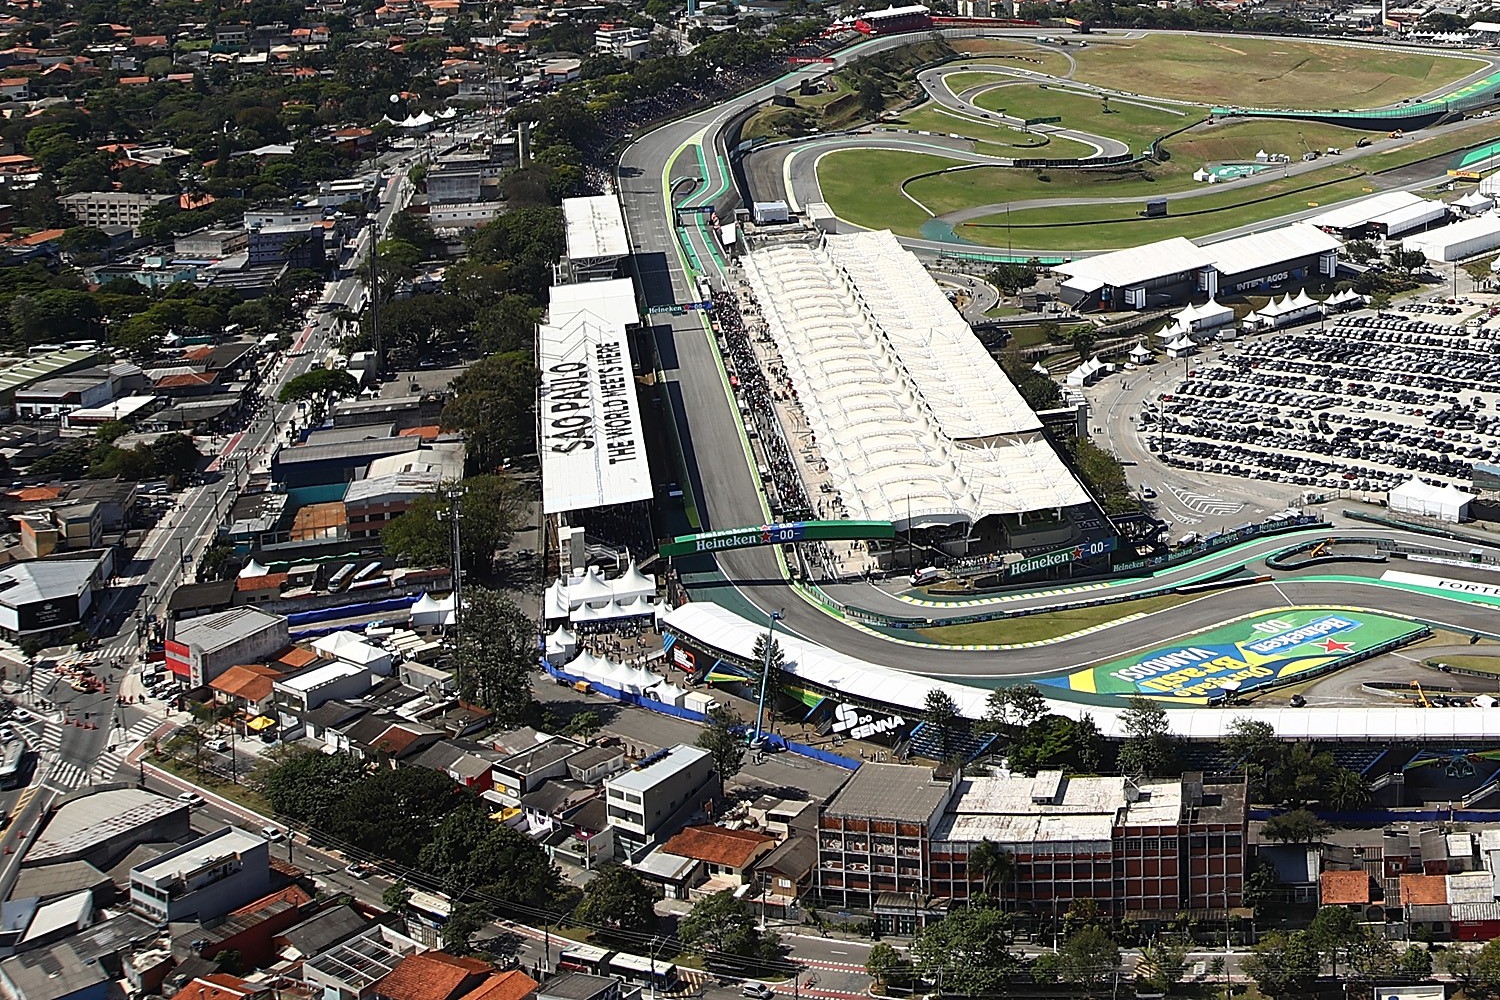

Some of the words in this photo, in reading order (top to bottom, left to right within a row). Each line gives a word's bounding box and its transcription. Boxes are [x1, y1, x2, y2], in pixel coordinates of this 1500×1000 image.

[649, 305, 683, 314] Heineken
[596, 342, 622, 366] HERE
[549, 363, 591, 413] PAULO
[598, 367, 627, 398] MEETS
[603, 400, 633, 440] WORLD
[607, 440, 637, 465] THE
[1259, 519, 1289, 531] Heineken
[695, 534, 757, 551] Heineken
[1167, 548, 1193, 561] Heineken
[1010, 552, 1069, 575] Heineken
[1113, 560, 1144, 573] Heineken
[1249, 616, 1352, 653] Heineken
[1109, 647, 1218, 683] VAMOS!
[1139, 655, 1246, 691] Brasil
[850, 715, 906, 740] SENNA
[858, 714, 873, 725] DO
